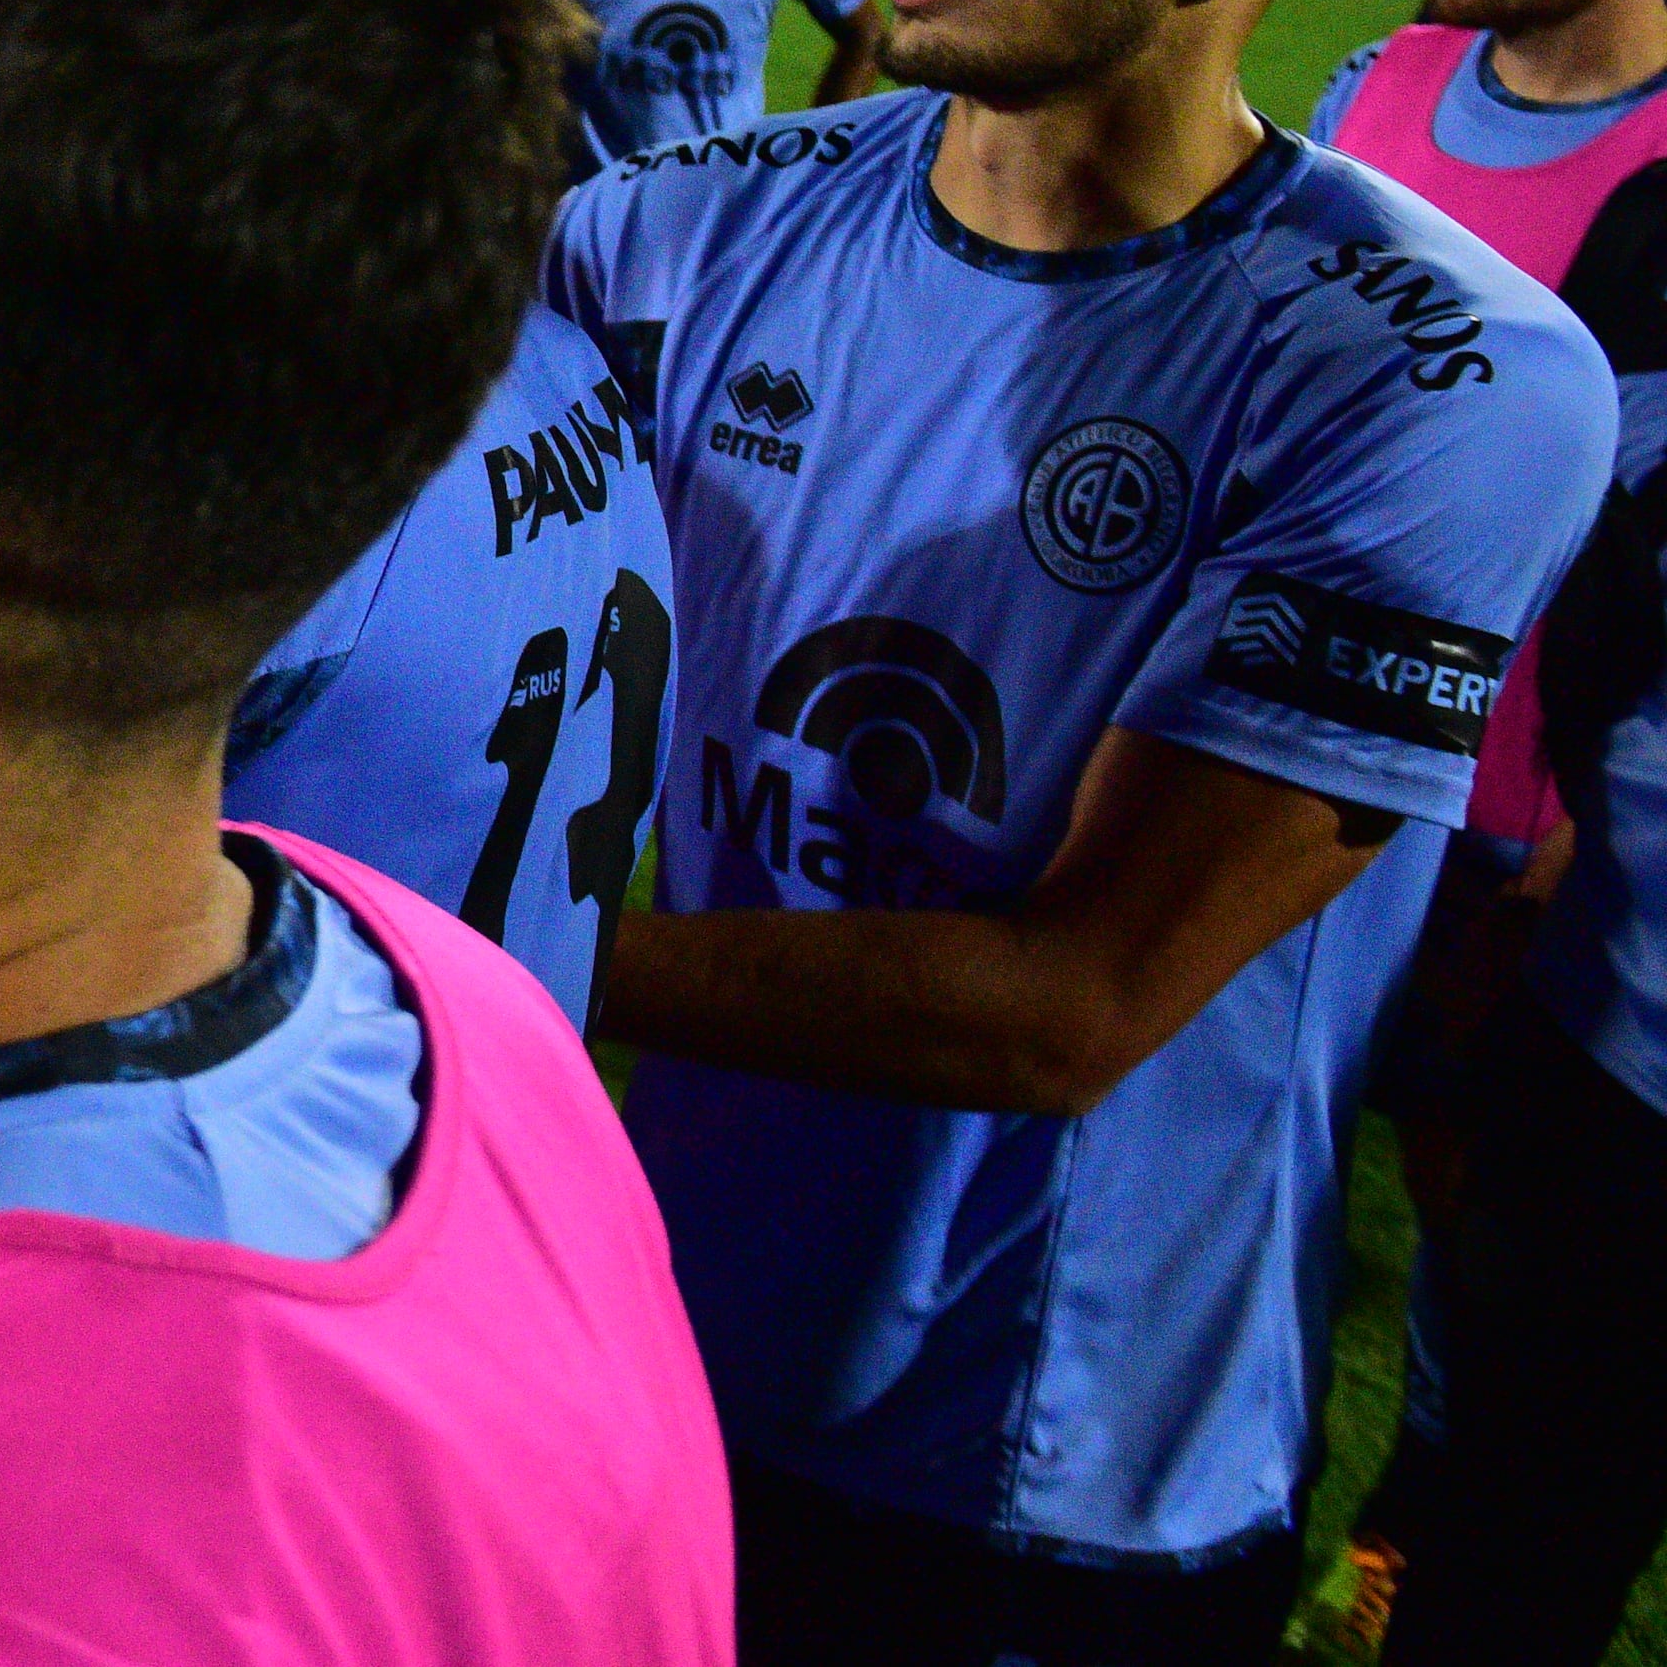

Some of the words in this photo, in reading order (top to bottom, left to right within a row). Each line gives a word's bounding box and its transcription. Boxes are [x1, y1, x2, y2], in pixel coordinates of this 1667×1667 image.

[620, 123, 857, 182] SANOS
[1308, 240, 1494, 392] SANOS
[710, 422, 803, 476] errea
[529, 667, 562, 700] RUS
